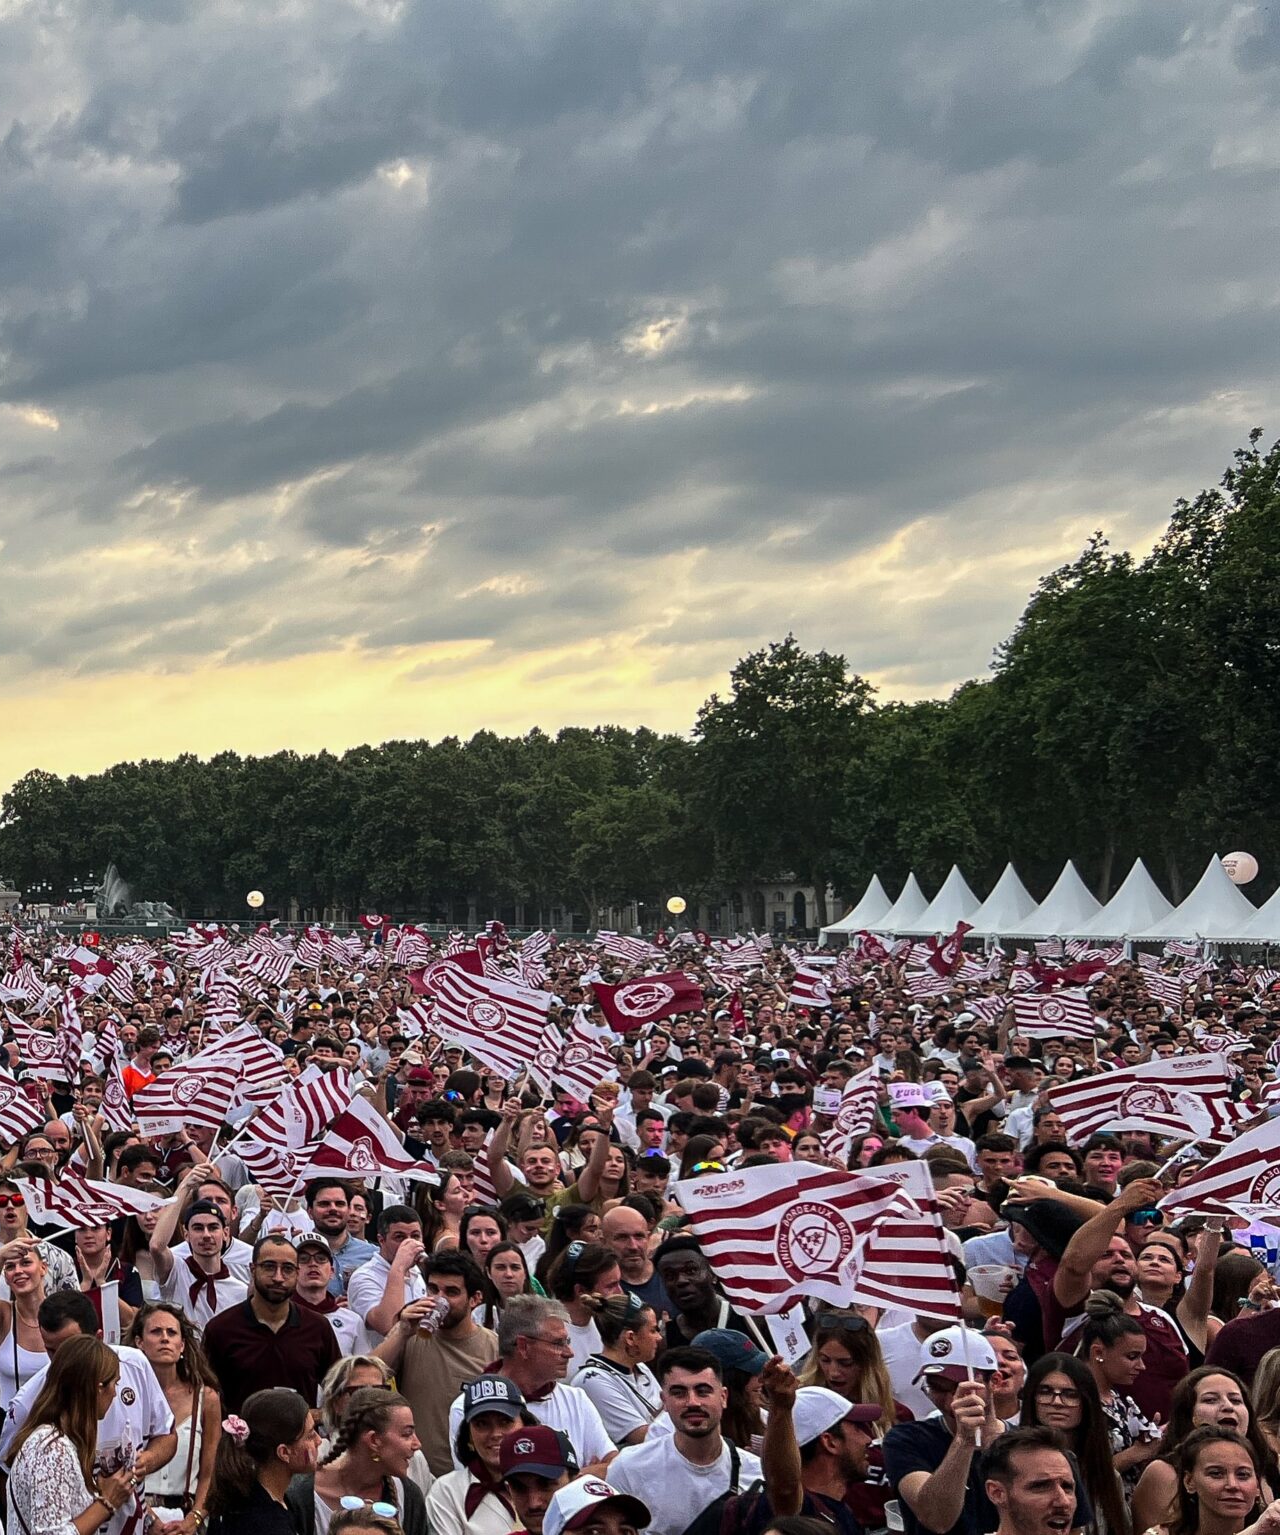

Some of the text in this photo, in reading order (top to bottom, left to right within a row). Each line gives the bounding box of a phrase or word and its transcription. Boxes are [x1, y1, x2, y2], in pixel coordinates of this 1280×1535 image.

[784, 1204, 834, 1228] BORDEAUX
[779, 1233, 791, 1269] UNION
[471, 1380, 509, 1400] UBB
